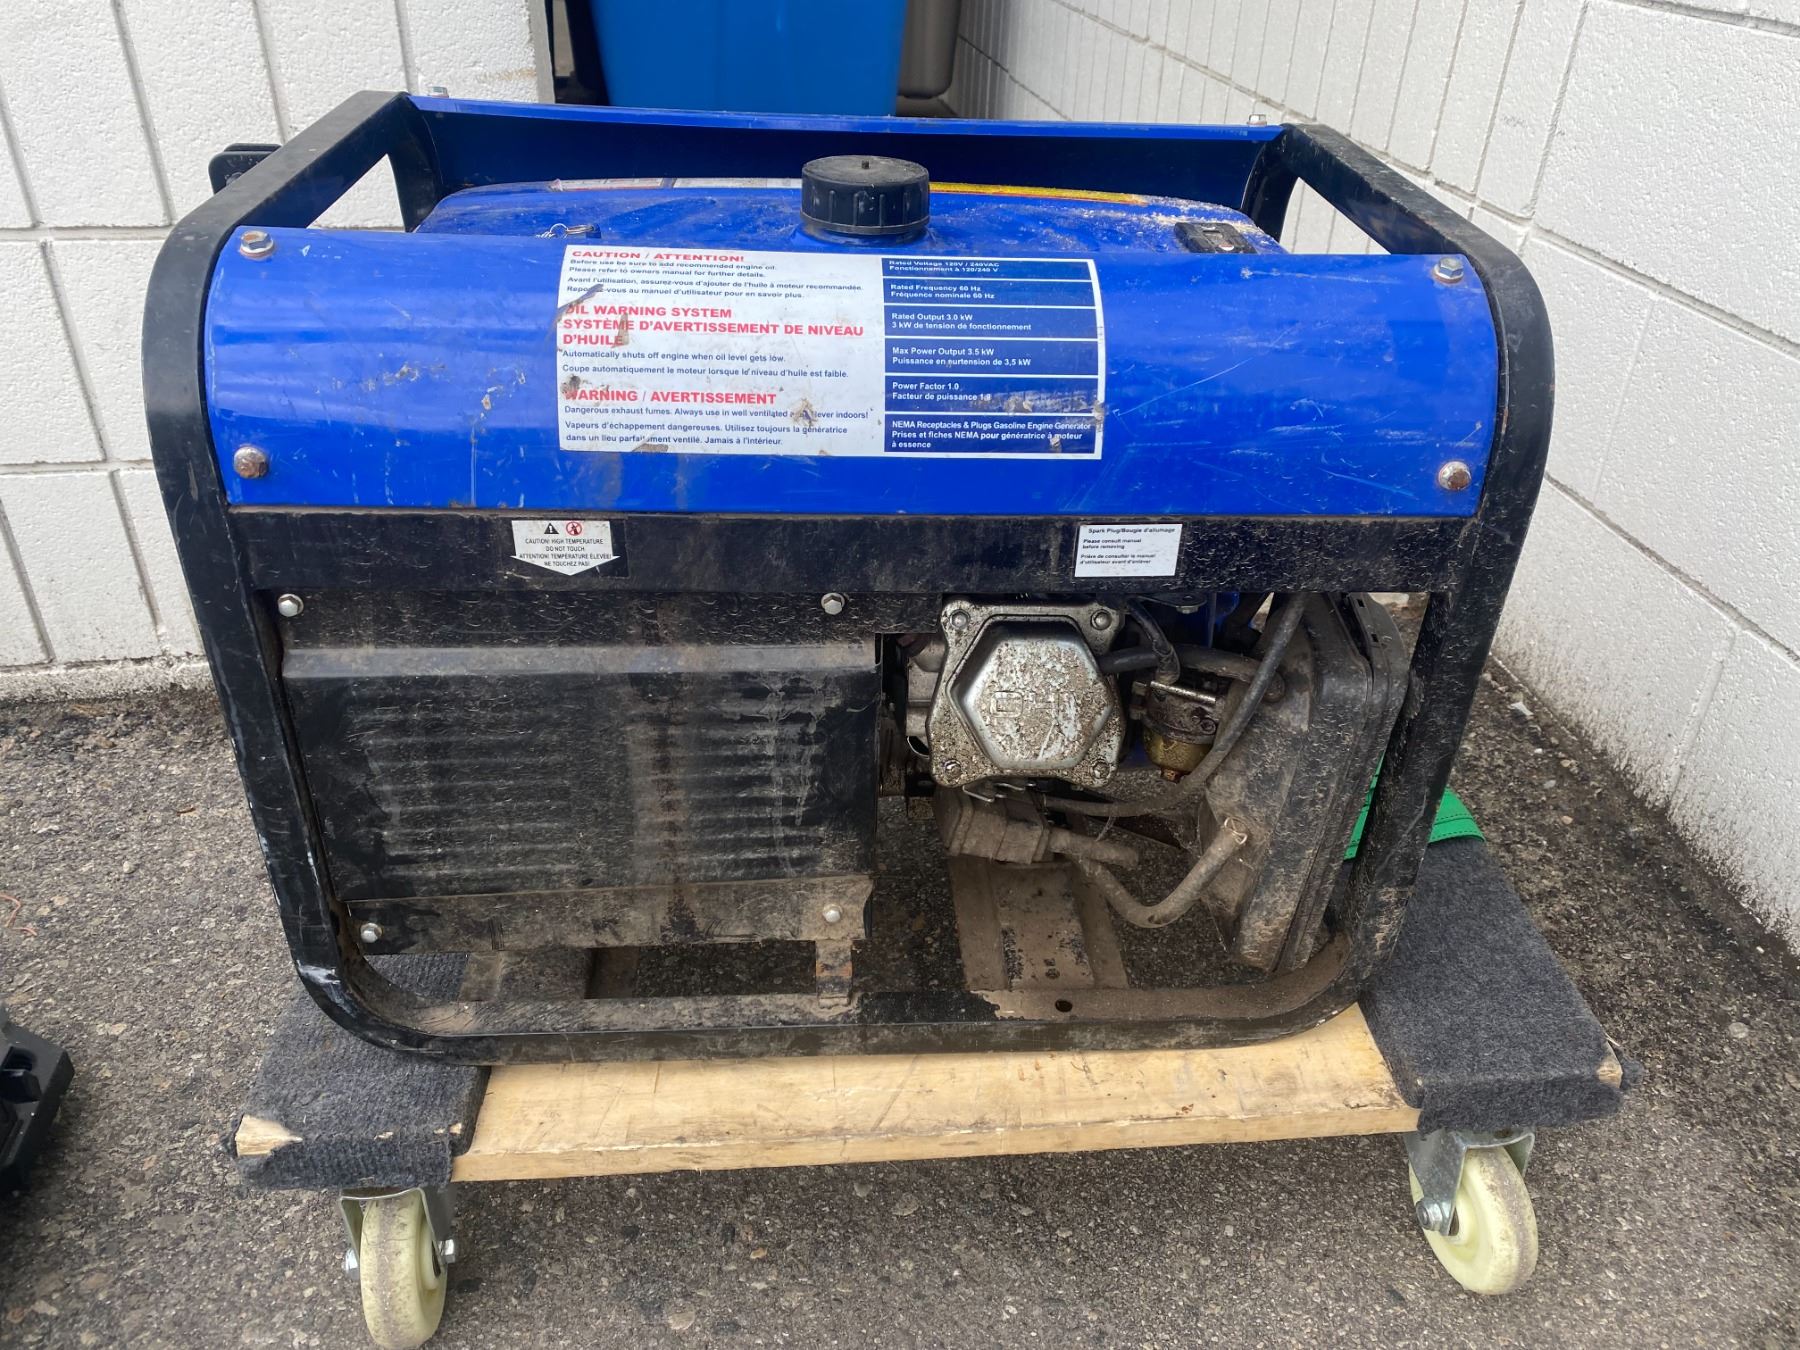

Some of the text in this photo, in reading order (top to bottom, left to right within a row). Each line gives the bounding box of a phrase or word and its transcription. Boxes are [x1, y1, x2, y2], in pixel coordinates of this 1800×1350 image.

[572, 251, 641, 259] CAUTION
[654, 254, 744, 262] ATTENTION!
[565, 304, 732, 318] OIL WARNING SYSTEM
[892, 313, 915, 322] Rated
[917, 314, 945, 322] Output
[563, 317, 864, 336] SYSTÈME D'AVERTISSEMENT DE NIVEAU
[563, 334, 623, 346] D'HUILE
[562, 350, 620, 359] Automatically
[661, 353, 689, 361] engine
[715, 353, 726, 361] oil
[749, 352, 767, 363] gets
[938, 348, 966, 356] Output
[562, 365, 590, 373] Coupe
[592, 366, 665, 374] automatiquement
[707, 368, 739, 376] lorsque
[780, 369, 808, 377] d'huile
[824, 370, 848, 378] faible.
[565, 389, 776, 404] WARNING / AVERTISSEMENT
[936, 393, 978, 402] puissance
[564, 405, 609, 415] Dangerous
[674, 408, 703, 417] Always
[749, 410, 788, 418] ventilated
[601, 422, 665, 431] d'échappement
[757, 426, 791, 434] toujours
[917, 421, 962, 429] Receptacles
[971, 422, 992, 430] Plugs
[1027, 422, 1054, 431] Engine
[1054, 422, 1091, 430] Generator
[743, 437, 783, 445] l'intérieur.
[980, 430, 1000, 440] pour
[1001, 432, 1046, 440] génératrice
